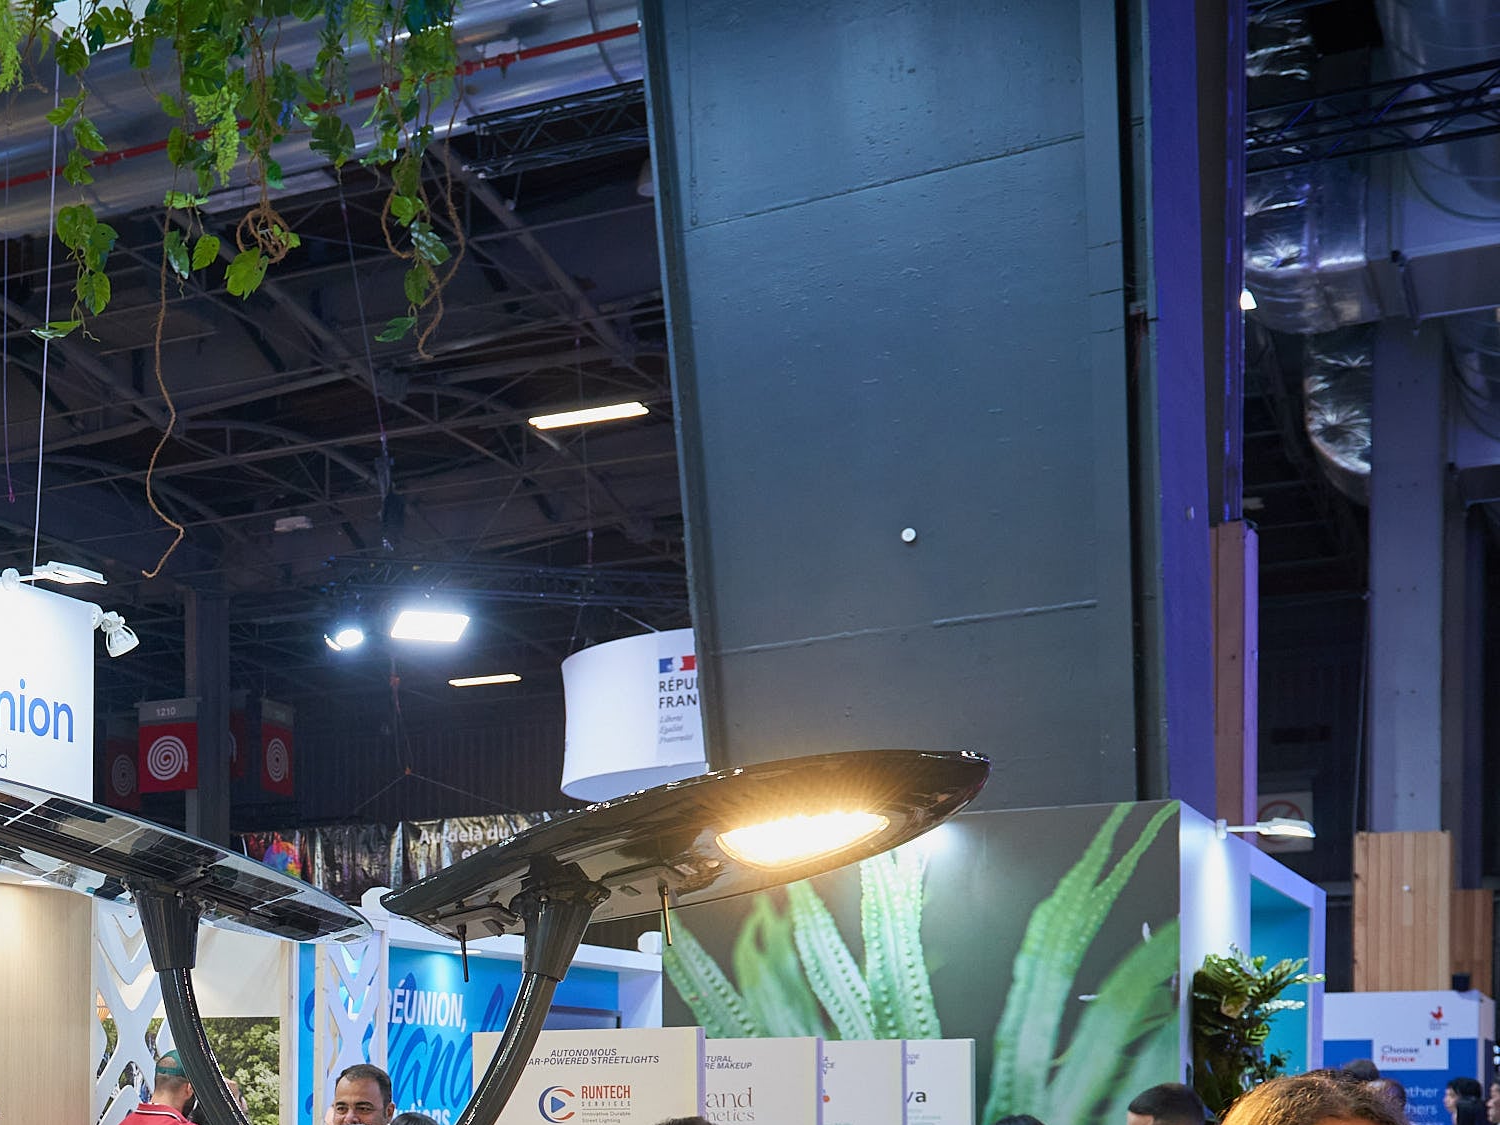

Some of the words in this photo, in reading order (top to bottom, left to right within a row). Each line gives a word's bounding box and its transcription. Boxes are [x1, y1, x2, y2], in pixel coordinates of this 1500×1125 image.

[658, 676, 698, 693] RÉPU
[658, 693, 698, 710] FRAN
[388, 978, 467, 1032] ÉUNION,
[528, 1056, 589, 1066] AR-POWERED
[591, 1055, 660, 1065] STREETLIGHTS
[550, 1048, 617, 1057] AUTONOMOUS
[716, 1062, 753, 1070] MAKEUP
[581, 1085, 631, 1100] RUNTECH
[706, 1086, 752, 1108] and
